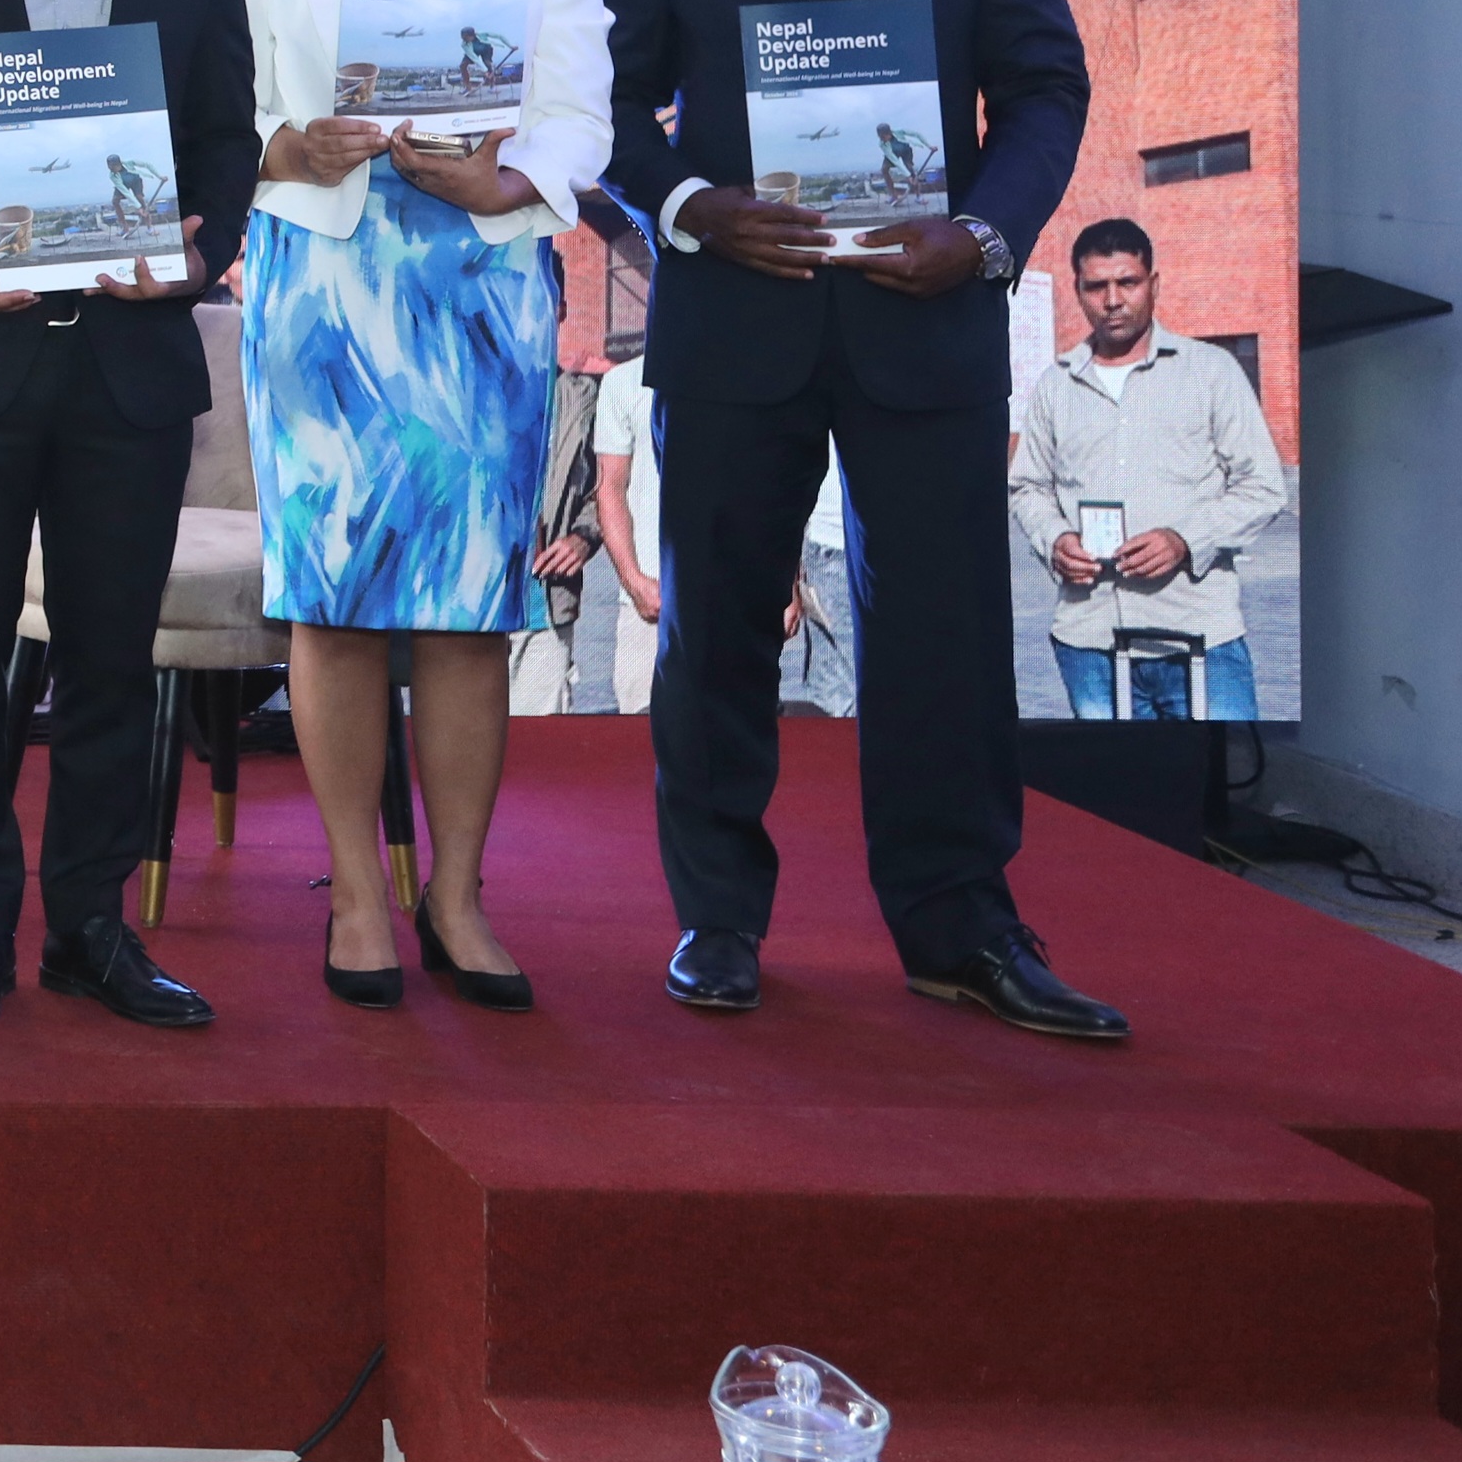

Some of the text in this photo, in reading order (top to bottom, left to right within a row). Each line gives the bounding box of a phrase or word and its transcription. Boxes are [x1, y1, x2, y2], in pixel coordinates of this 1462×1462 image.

[756, 18, 813, 40] Nepal
[758, 32, 888, 55] Development
[759, 54, 830, 75] Update
[760, 75, 800, 84] International
[801, 73, 830, 82] Migration
[882, 69, 900, 77] Nepal
[32, 105, 60, 113] Migration
[111, 99, 128, 107] Nepal
